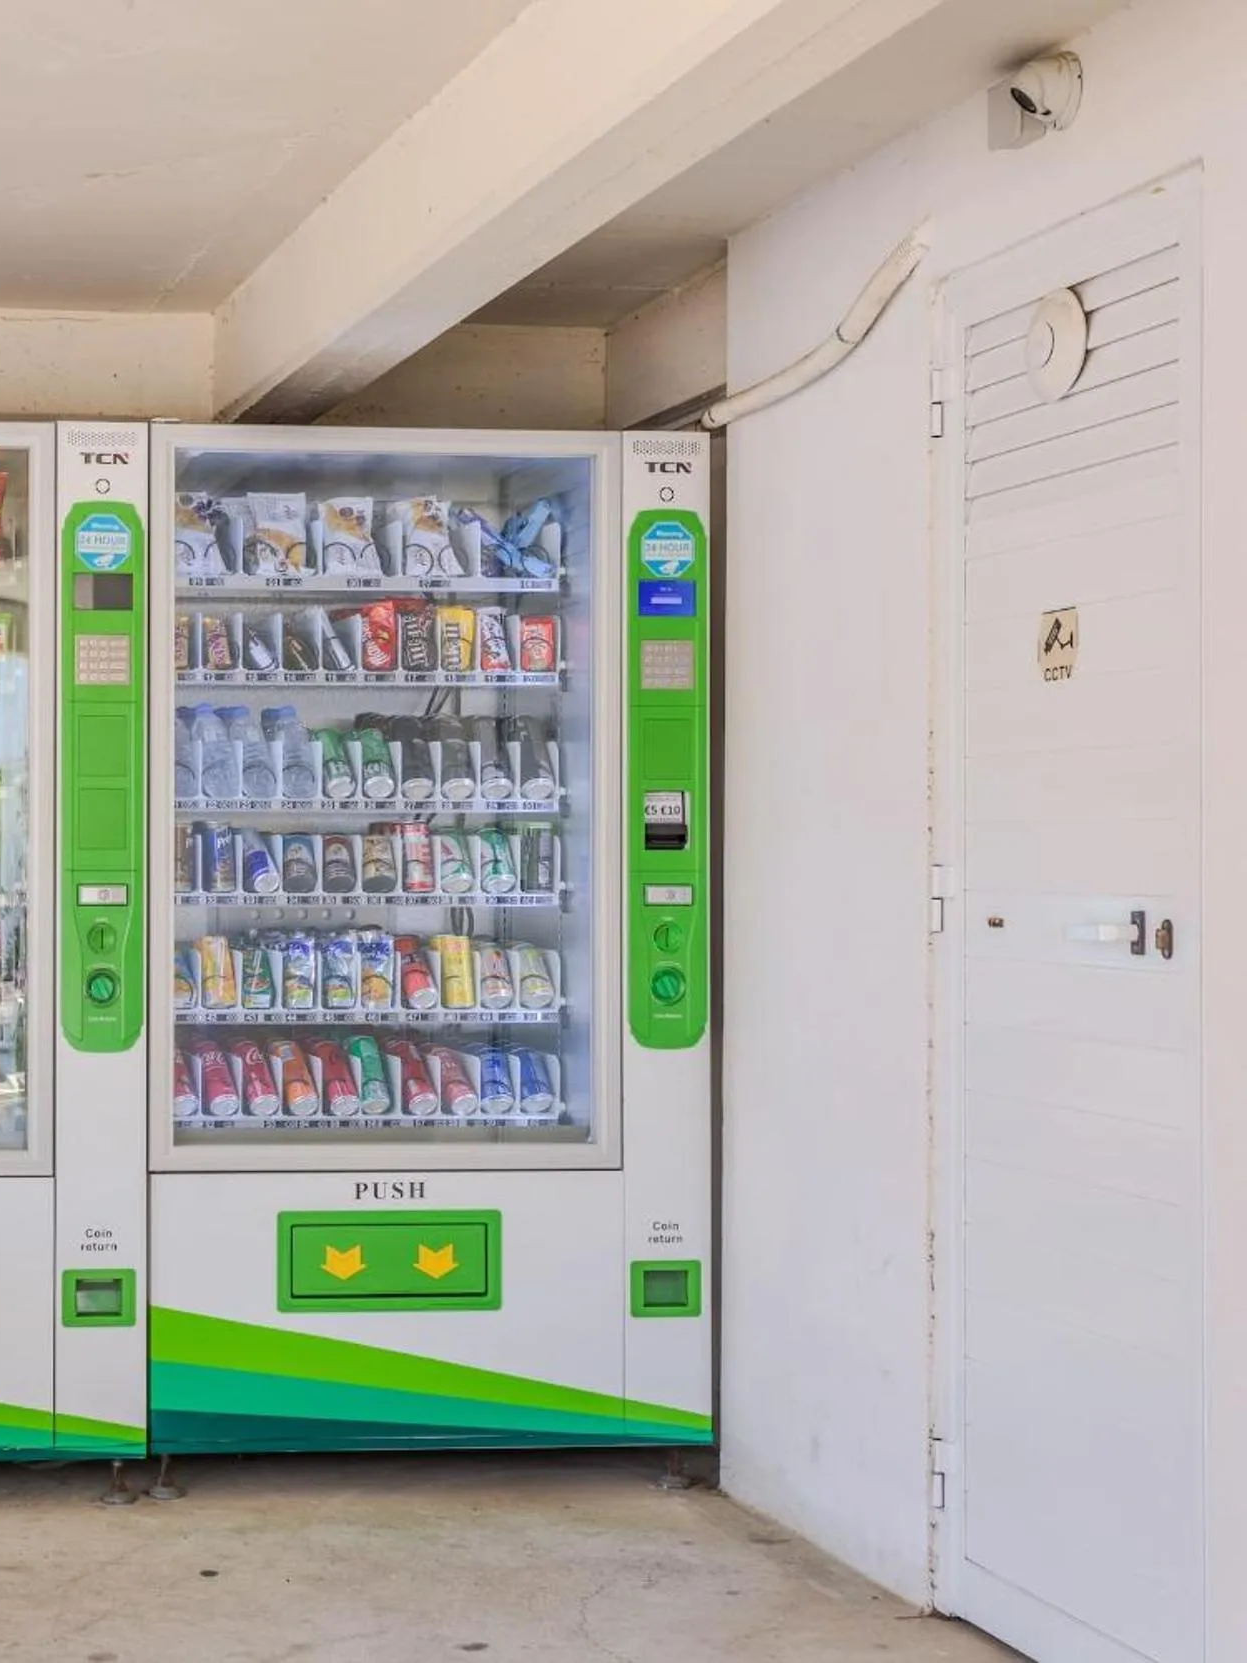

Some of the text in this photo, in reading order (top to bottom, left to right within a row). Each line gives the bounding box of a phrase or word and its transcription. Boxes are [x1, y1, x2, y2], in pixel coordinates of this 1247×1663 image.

[79, 451, 129, 465] TCN
[644, 461, 692, 473] TCN
[1043, 663, 1073, 682] CCTV
[644, 803, 681, 816] €5 €10
[353, 1181, 425, 1200] PUSH
[652, 1220, 679, 1231] Coin
[85, 1228, 113, 1239] Coin
[648, 1234, 684, 1244] return
[80, 1242, 118, 1252] return
